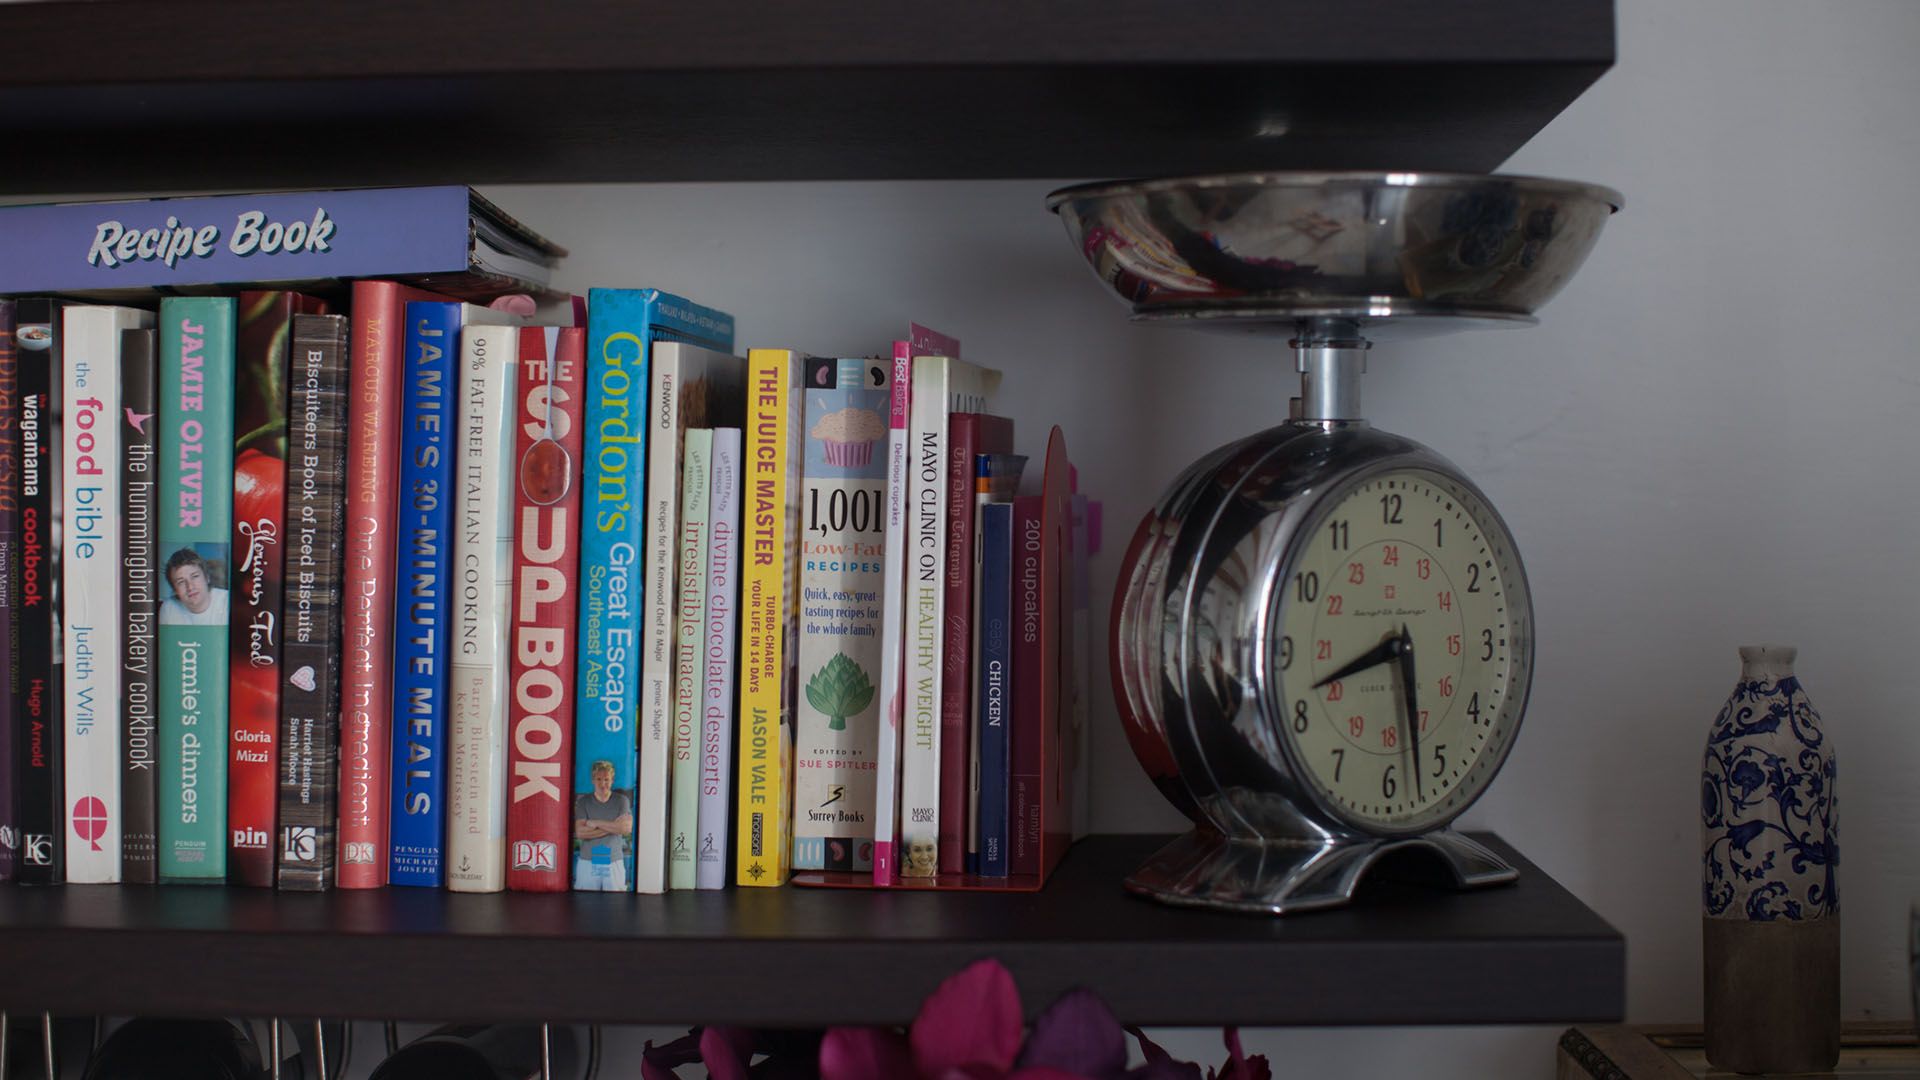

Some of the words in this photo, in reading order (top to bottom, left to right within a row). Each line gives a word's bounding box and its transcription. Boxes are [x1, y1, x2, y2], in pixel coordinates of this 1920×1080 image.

[88, 216, 220, 267] Recipe
[229, 208, 337, 255] Book
[180, 318, 205, 411] JAMIE
[364, 319, 381, 403] MARCUS
[471, 338, 487, 370] 99%
[523, 359, 573, 382] THE
[895, 357, 907, 383] Best
[75, 362, 91, 388] the
[413, 319, 443, 469] JAMIE'S
[759, 366, 778, 407] THE
[304, 350, 322, 450] Biscuiteers
[469, 378, 485, 457] FAT-FREE
[660, 374, 672, 429] KENWOOD
[20, 394, 40, 495] wagamama
[76, 397, 104, 476] food
[597, 332, 643, 532] Gordon's
[757, 412, 777, 473] JUICE
[128, 443, 152, 472] the
[180, 419, 203, 528] OLIVER
[361, 410, 379, 504] WAREING
[893, 443, 903, 483] Delicious
[920, 432, 937, 482] MAYO
[953, 447, 966, 476] The
[302, 455, 319, 501] Book
[301, 505, 317, 524] of
[466, 464, 481, 545] ITALIAN
[809, 488, 883, 538] 1,001
[891, 486, 901, 526] cupcakes
[951, 480, 965, 516] Daily
[1380, 494, 1403, 525] 12
[76, 487, 103, 559] bible
[658, 501, 669, 536] Recipes
[755, 479, 775, 566] MASTER
[920, 488, 937, 548] CLINIC
[1025, 519, 1040, 551] 200
[1329, 520, 1348, 551] 11
[1434, 518, 1442, 548] 1
[24, 508, 42, 606] cookbook
[124, 481, 154, 602] hummingbird
[300, 528, 317, 566] Iced
[353, 517, 378, 570] One
[658, 539, 668, 547] for
[658, 550, 667, 564] the
[712, 521, 734, 587] divine
[803, 541, 885, 557] Low-Fat
[950, 520, 965, 587] Telegraph
[1383, 545, 1399, 567] 24
[238, 518, 277, 605] Glorious
[408, 479, 438, 676] 30-MINUTE
[609, 542, 635, 619] Great
[681, 521, 704, 637] irresistible
[806, 561, 881, 573] RECIPES
[919, 554, 935, 581] ON
[1348, 562, 1364, 585] 23
[1417, 559, 1431, 580] 13
[1467, 563, 1480, 593] 2
[462, 554, 480, 655] COOKING
[656, 567, 667, 605] Kenwood
[751, 580, 762, 607] YOUR
[804, 587, 831, 602] Quick,
[833, 590, 853, 604] easy,
[1021, 556, 1040, 643] cupcakes
[1295, 571, 1318, 603] 10
[1437, 591, 1451, 612] 14
[298, 571, 315, 642] Biscuits
[351, 577, 377, 672] Perfect
[588, 565, 606, 655] Southeast
[656, 608, 665, 630] Chef
[750, 611, 761, 633] LIFE
[805, 606, 834, 620] tasting
[835, 607, 865, 621] recipes
[866, 607, 879, 620] for
[1327, 595, 1343, 616] 22
[125, 612, 154, 673] bakery
[248, 611, 275, 668] Food
[708, 594, 730, 699] chocolate
[750, 636, 760, 647] IN
[764, 595, 776, 678] TURBO-CHARGE
[806, 623, 820, 634] the
[822, 623, 848, 635] whole
[849, 624, 876, 638] family
[917, 588, 934, 671] HEALTHY
[1446, 635, 1461, 656] 15
[1481, 629, 1493, 662] 3
[72, 624, 94, 680] Judith
[654, 638, 665, 662] Major
[750, 650, 760, 664] 14
[1280, 636, 1293, 670] 9
[1317, 640, 1332, 660] 21
[28, 680, 44, 716] Hugo
[178, 641, 201, 725] jamie's
[468, 677, 483, 719] Barry
[586, 660, 603, 698] Asia
[601, 628, 632, 732] Escape
[653, 680, 663, 707] Jennie
[749, 667, 760, 694] DAYS
[989, 660, 1001, 727] CHICKEN
[1327, 680, 1343, 702] 20
[1438, 675, 1452, 697] 16
[76, 687, 95, 736] Wills
[455, 692, 467, 734] Kevin
[514, 627, 565, 803] BOOK
[677, 644, 696, 761] macaroons
[916, 677, 933, 750] WEIGHT
[1294, 699, 1308, 733] 8
[1467, 692, 1480, 724] 4
[31, 721, 45, 766] Arnold
[129, 682, 155, 770] cookbook
[234, 729, 272, 743] Gloria
[289, 718, 300, 750] Sarah
[301, 718, 314, 757] Harriet
[652, 709, 663, 741] Shapter
[752, 707, 767, 760] JASON
[1348, 716, 1364, 738] 19
[1381, 725, 1397, 748] 18
[236, 749, 269, 762] Mizzi
[288, 751, 299, 785] Moore
[349, 682, 375, 827] Ingredient
[404, 687, 433, 815] MEALS
[468, 727, 483, 799] Bluestein
[703, 706, 724, 796] desserts
[800, 760, 822, 768] SUE
[827, 760, 876, 770] SPITLER
[1331, 749, 1344, 782] 7
[1433, 744, 1446, 778] 5
[182, 732, 202, 824] dinners
[300, 758, 313, 803] Hastings
[453, 743, 467, 820] Morrissey
[750, 764, 766, 804] VALE
[1382, 764, 1396, 798] 6
[468, 807, 481, 834] and
[751, 812, 763, 857] thorsons
[808, 810, 836, 824] Surrey
[838, 811, 864, 823] Books
[1027, 804, 1040, 844] hamlyn
[233, 826, 268, 848] pin
[394, 846, 440, 854] PENGUIN
[516, 843, 552, 866] DK
[396, 866, 436, 874] JOSEPH
[880, 858, 886, 869] 1
